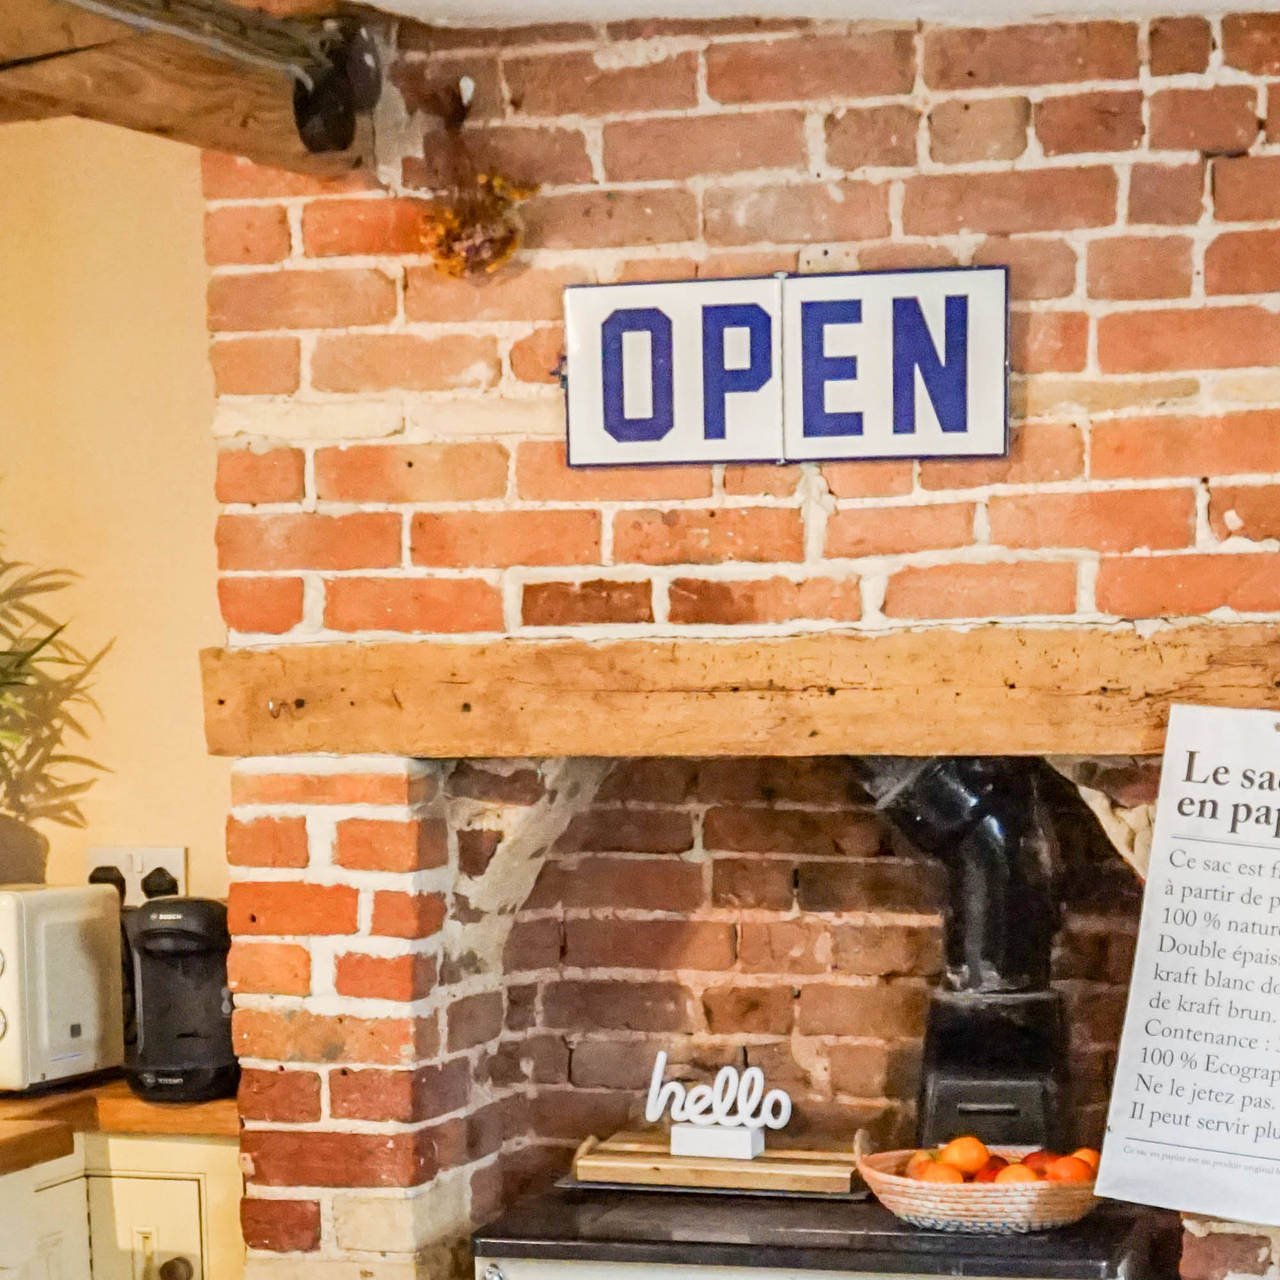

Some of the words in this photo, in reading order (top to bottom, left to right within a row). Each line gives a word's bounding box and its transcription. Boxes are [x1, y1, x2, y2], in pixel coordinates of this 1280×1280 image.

[601, 295, 969, 443] OPEN
[1182, 750, 1230, 785] Le
[1177, 795, 1218, 820] en
[1169, 849, 1196, 869] Ce
[1202, 855, 1231, 873] sac
[1238, 860, 1264, 877] est
[1164, 880, 1174, 896] à
[1180, 884, 1235, 904] partir
[1240, 886, 1263, 906] de
[1161, 906, 1197, 928] 100
[1203, 911, 1221, 931] %
[1158, 933, 1227, 960] Double
[1153, 962, 1199, 987] kraft
[1204, 968, 1256, 993] blanc
[1148, 990, 1170, 1010] de
[1176, 993, 1222, 1017] kraft
[1228, 1000, 1277, 1024] brun.
[1144, 1018, 1258, 1051] Contenance
[1140, 1046, 1175, 1068] 100
[1180, 1050, 1198, 1071] %
[645, 1050, 793, 1131] hello
[1134, 1072, 1164, 1095] Ne
[1170, 1078, 1186, 1098] le
[1190, 1084, 1235, 1106] jetez
[1240, 1094, 1276, 1113] pas.
[1149, 1108, 1192, 1128] peut
[1197, 1114, 1250, 1136] servir
